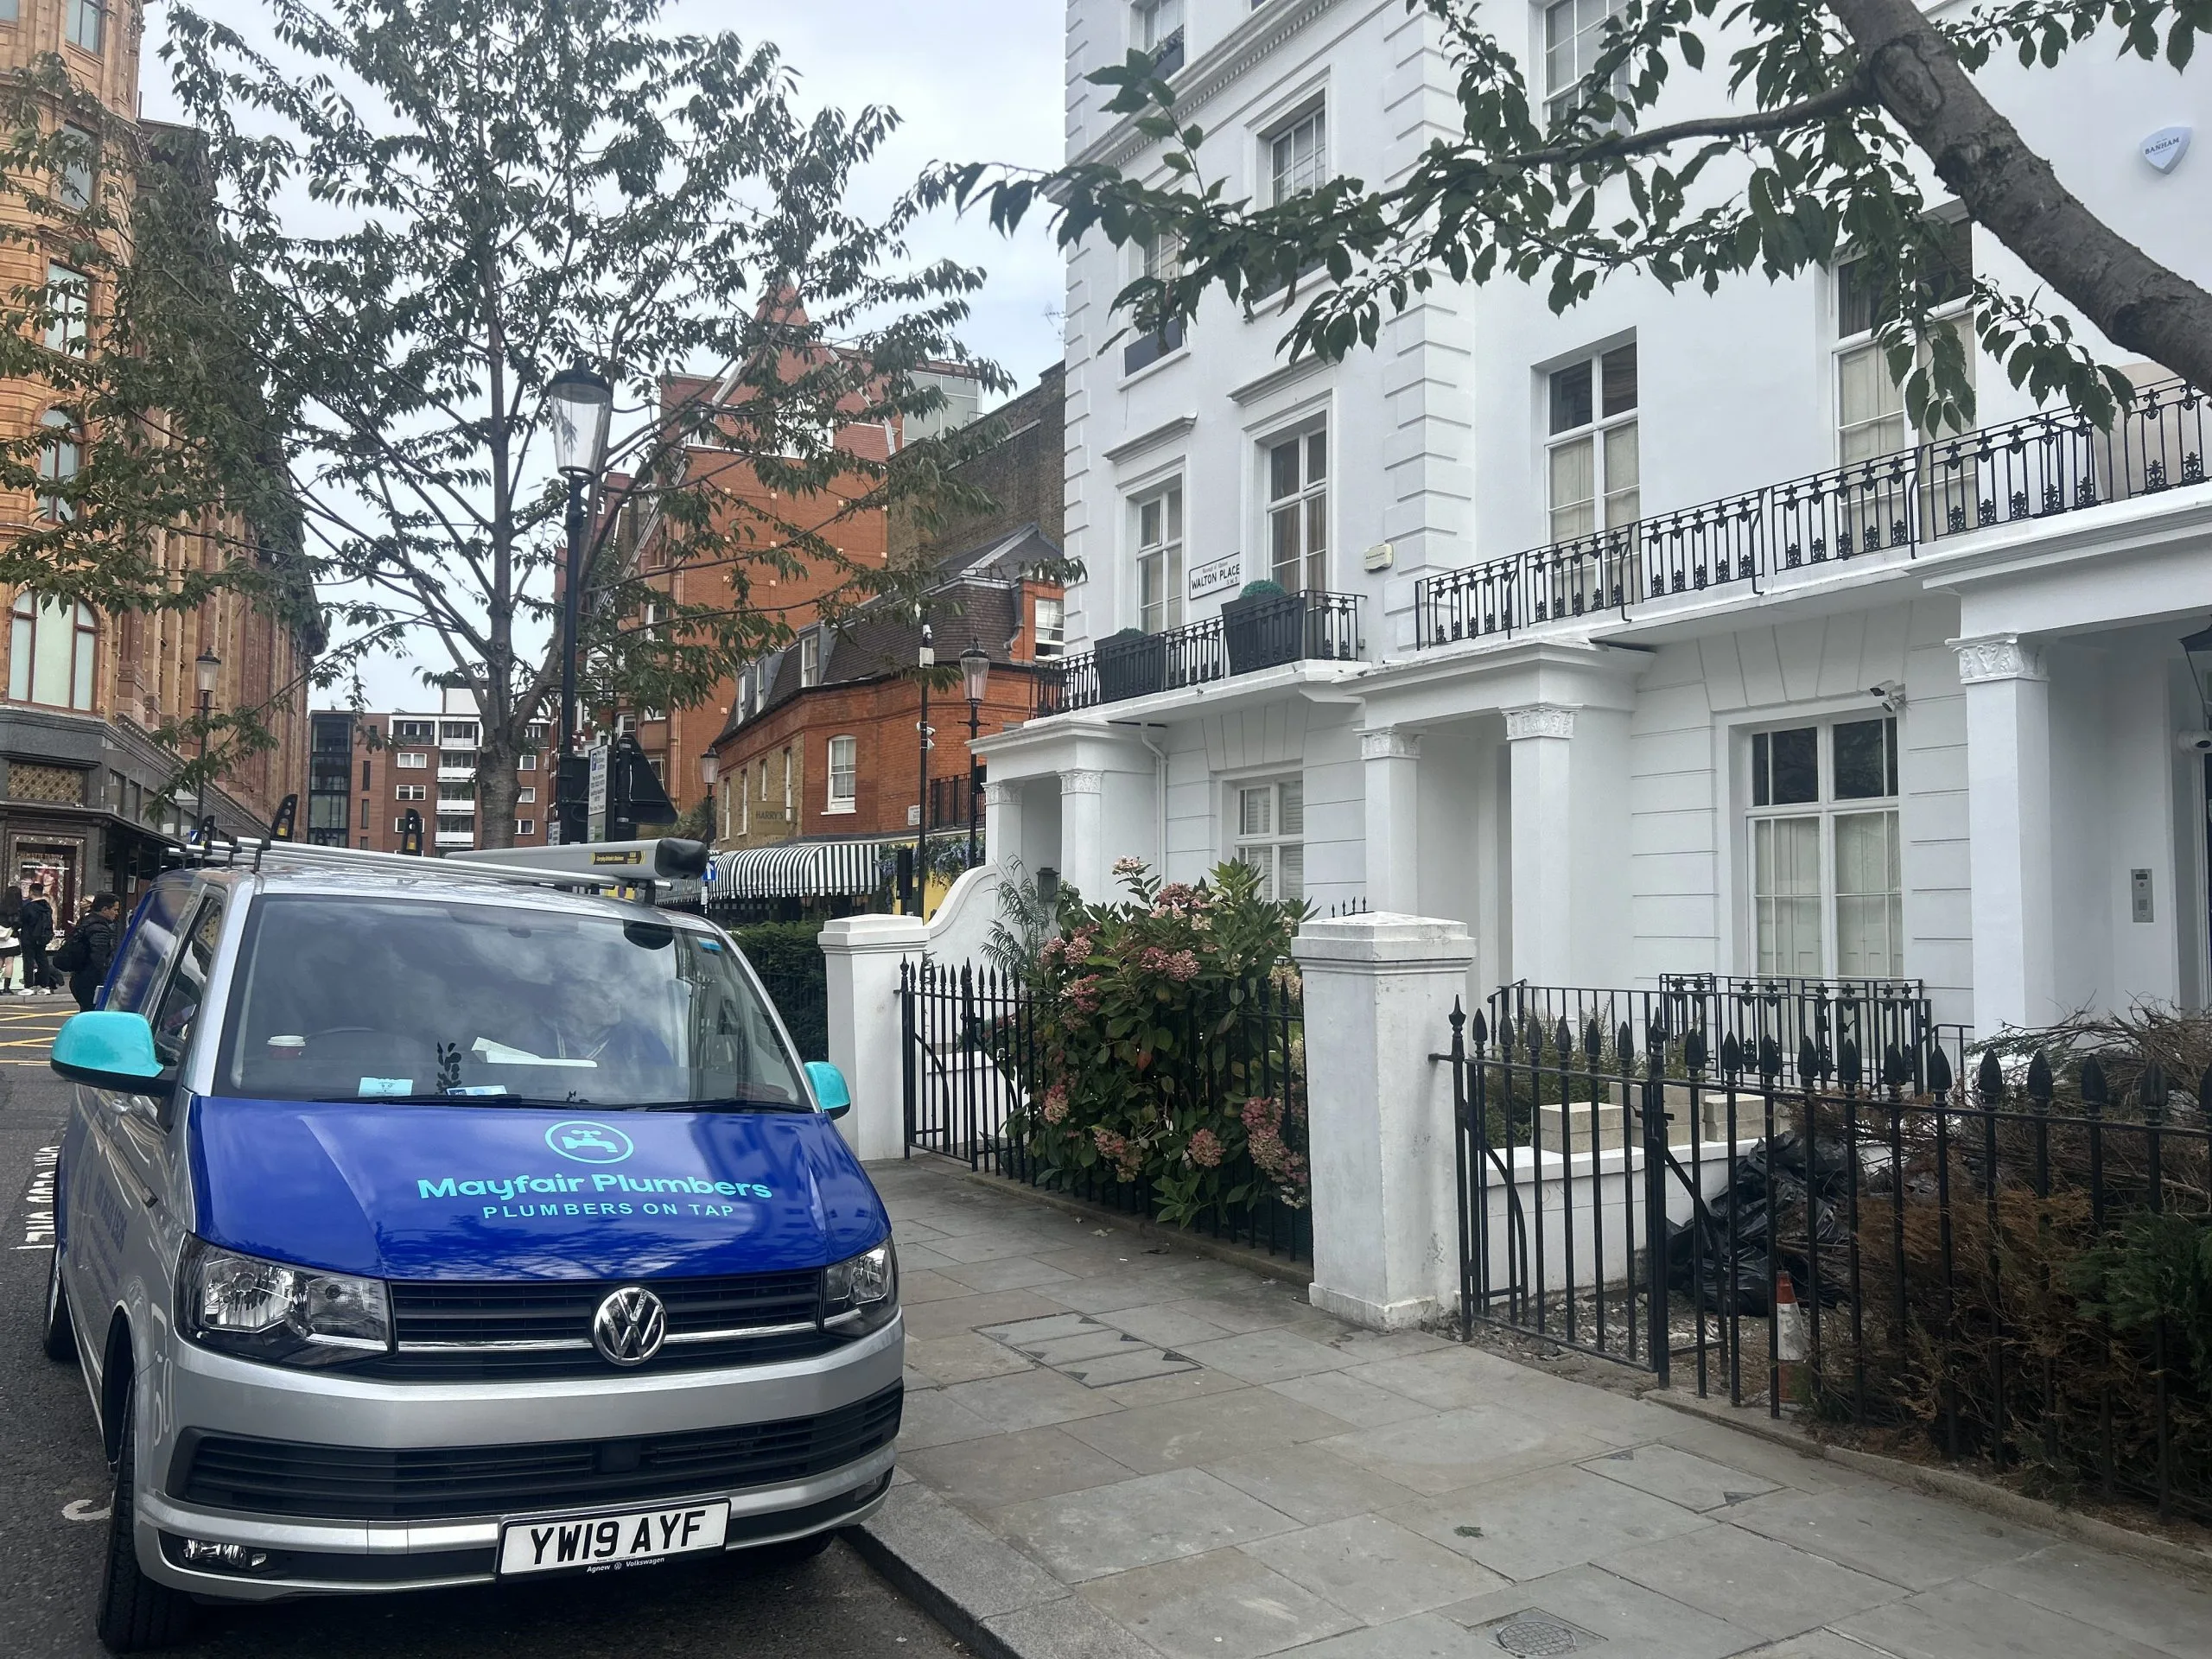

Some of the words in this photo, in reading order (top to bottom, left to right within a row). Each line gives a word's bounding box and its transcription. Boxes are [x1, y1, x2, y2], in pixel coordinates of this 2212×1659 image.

[2145, 137, 2179, 155] BANHAM
[1192, 572, 1217, 590] WALTON
[1219, 563, 1240, 581] PLACE
[755, 810, 784, 820] HARRY'S
[417, 1173, 585, 1200] Mayfair
[590, 1173, 772, 1198] Plumbers
[483, 1202, 633, 1219] PLUMBERS
[643, 1203, 677, 1215] ON
[688, 1204, 734, 1217] TAP
[530, 1521, 620, 1565] YW19
[629, 1510, 706, 1554] AYF
[586, 1564, 611, 1573] Agnew
[626, 1556, 665, 1567] Volkswagen
